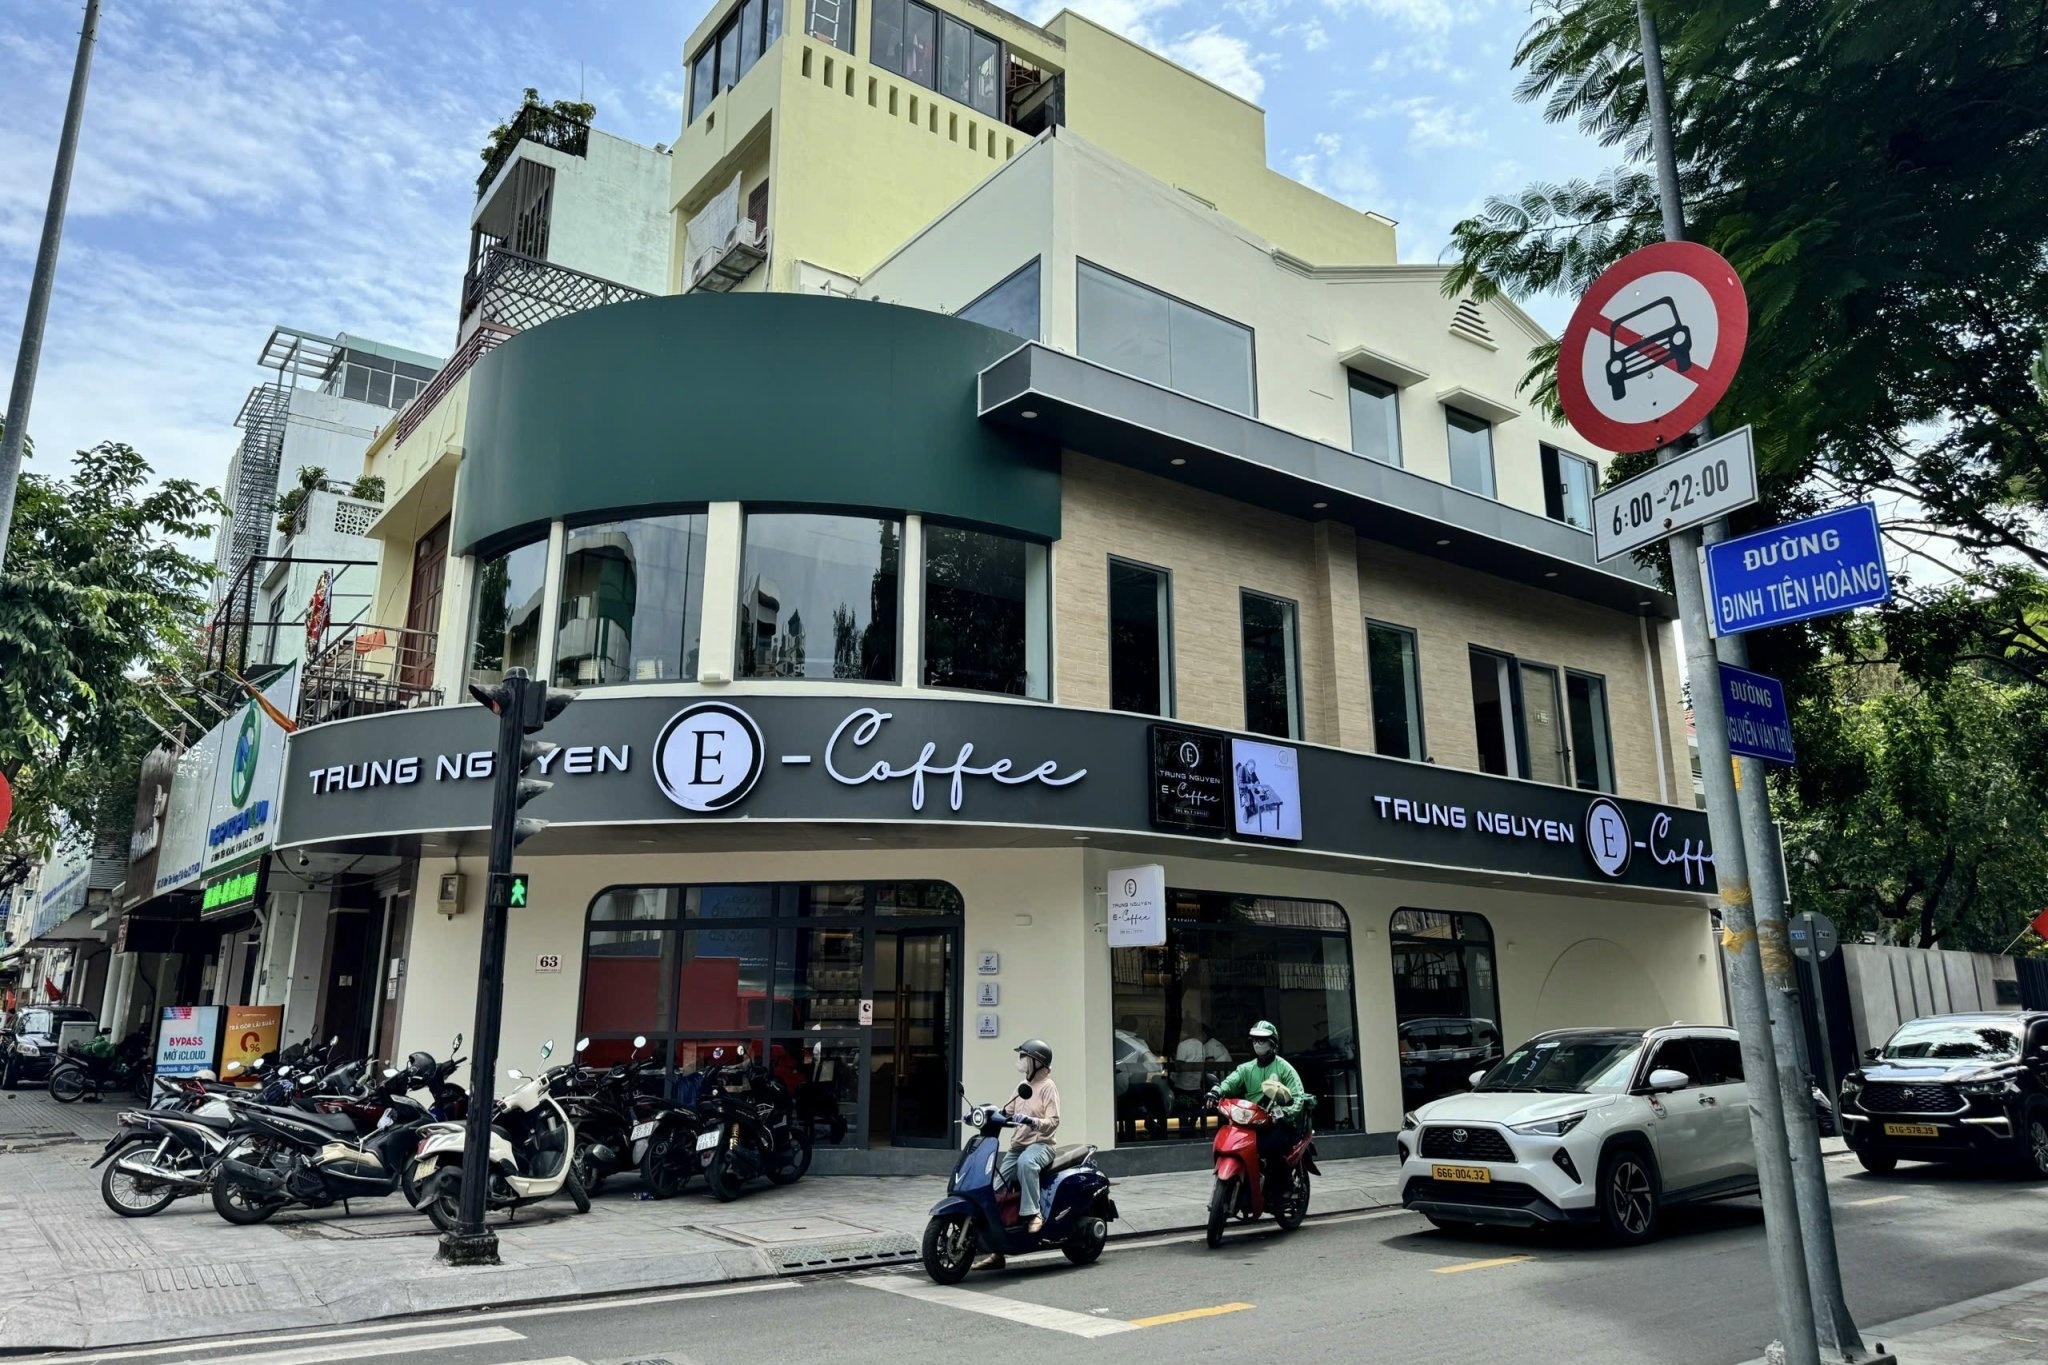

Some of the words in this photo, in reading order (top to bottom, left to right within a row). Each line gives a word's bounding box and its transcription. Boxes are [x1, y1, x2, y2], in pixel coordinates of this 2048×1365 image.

[1743, 528, 1841, 572] ĐƯỜNG
[1721, 586, 1765, 624] ĐINH
[1770, 574, 1808, 613] TIÊN
[1814, 560, 1881, 604] HOÀNG
[1730, 680, 1772, 708] ĐƯỜNG
[309, 756, 421, 795] TRUNG
[435, 744, 630, 782] NGYEN
[825, 707, 1088, 811] Coffee
[1159, 769, 1187, 780] TRUNG
[1188, 774, 1221, 784] NGUYEN
[1374, 795, 1467, 829] TRUNG
[1477, 811, 1575, 843] NGUYEN
[540, 955, 558, 968] 63
[169, 1036, 203, 1047] BYPASS
[163, 1048, 176, 1061] MỞ
[178, 1051, 206, 1060] iCLOUD
[1436, 1167, 1485, 1180] 66G-004.32
